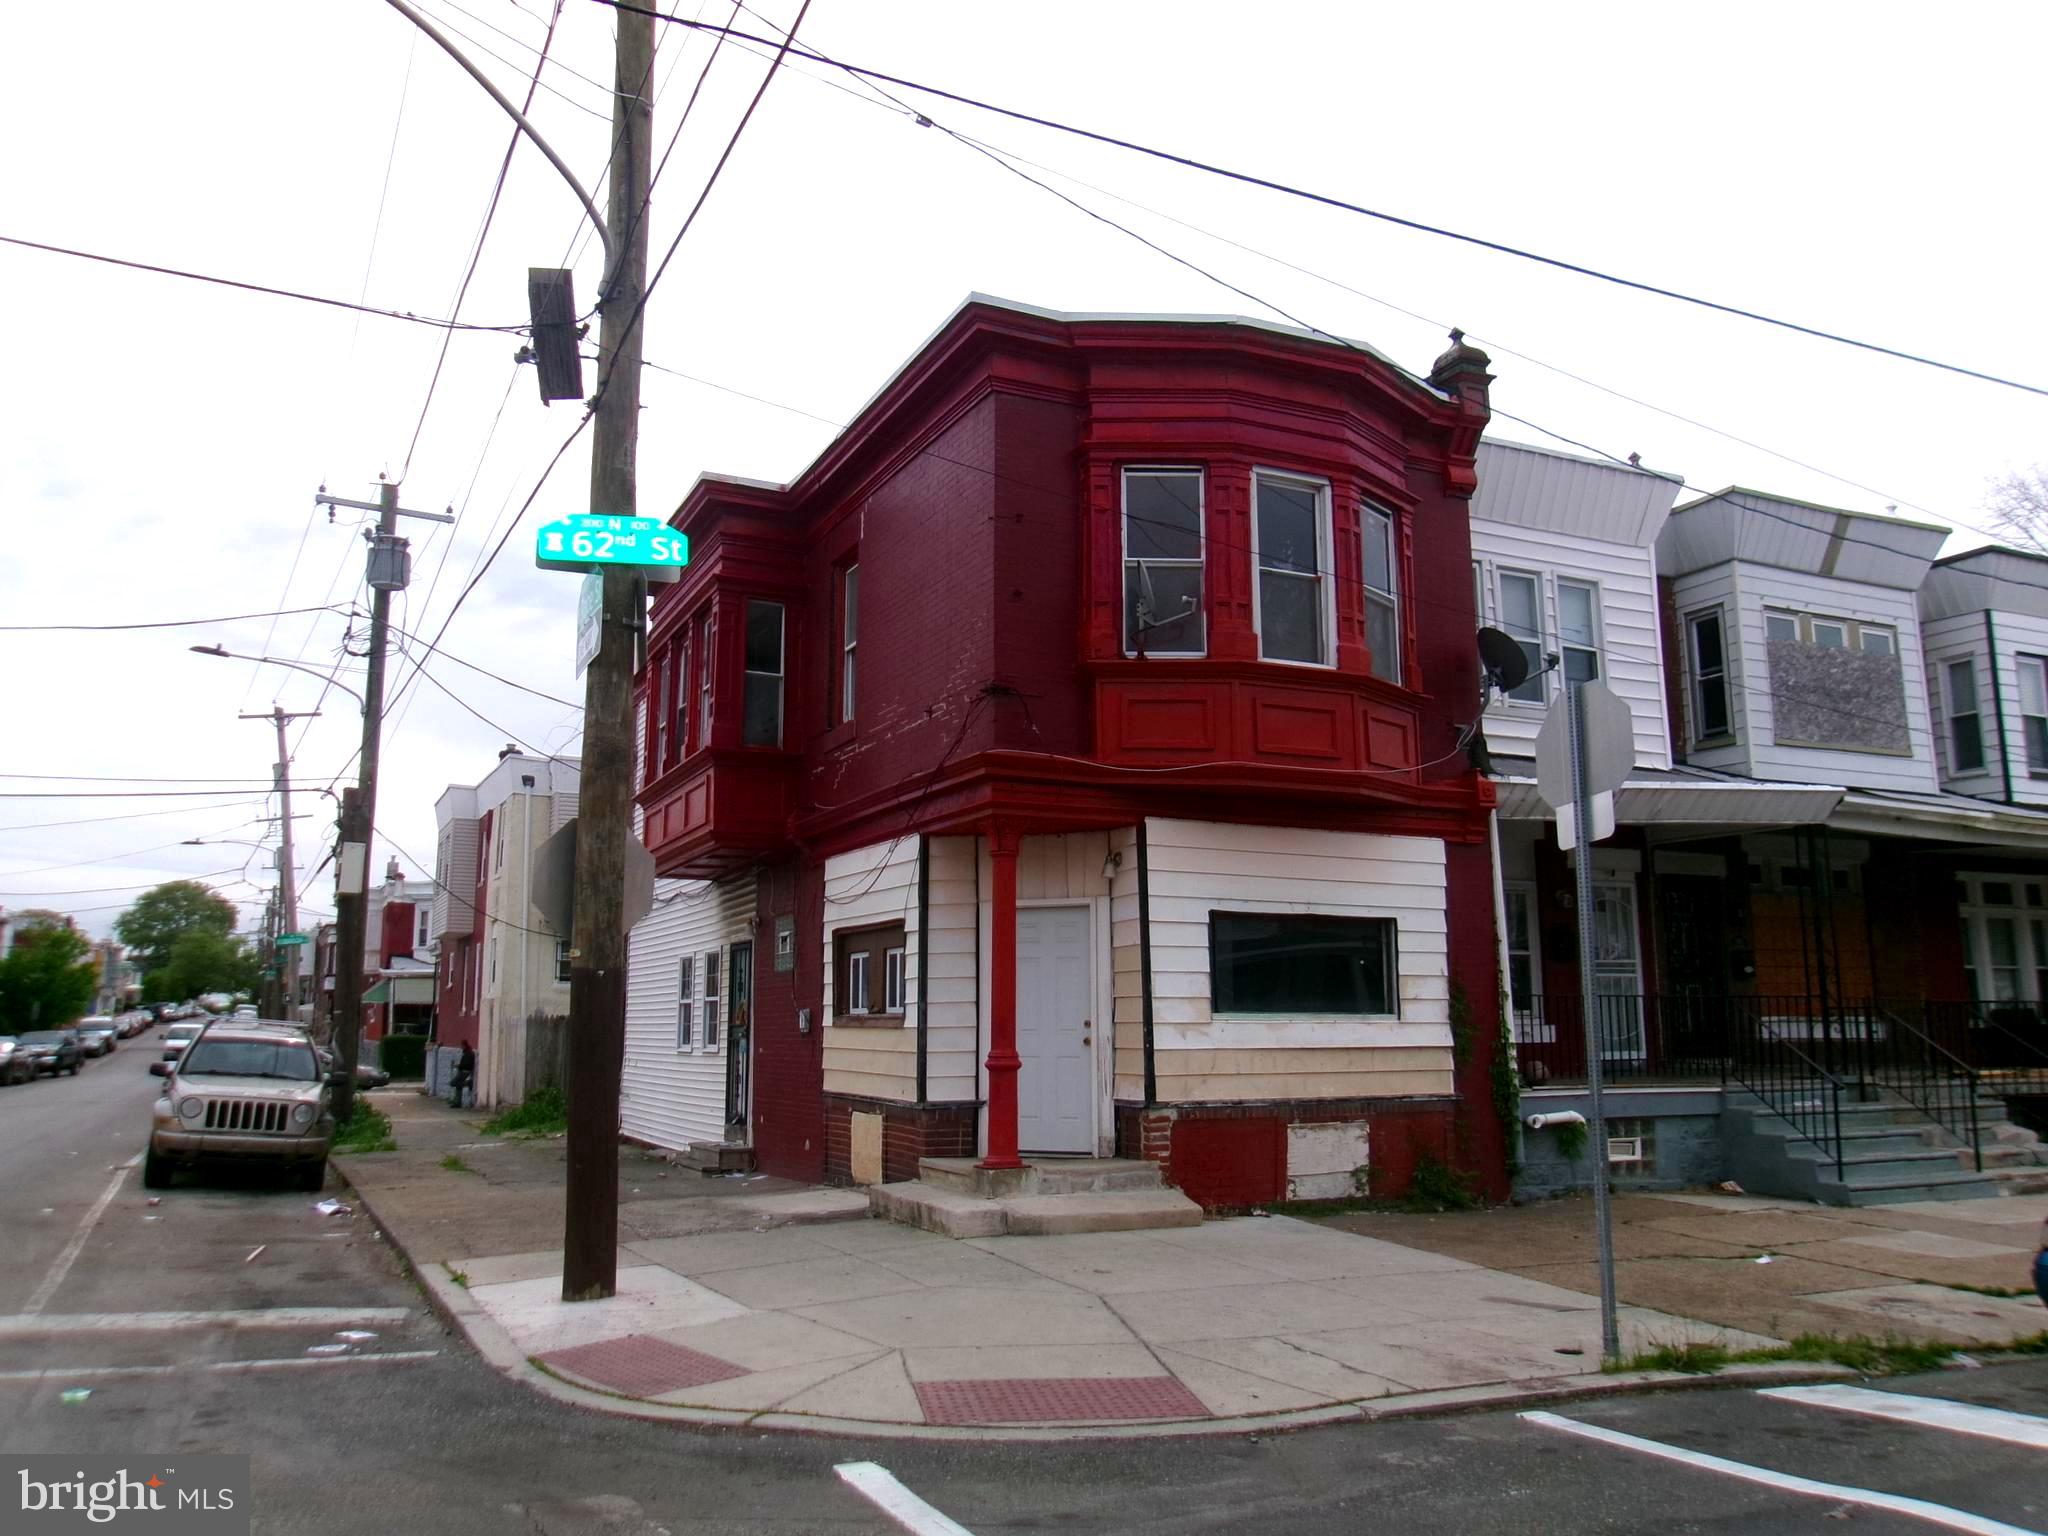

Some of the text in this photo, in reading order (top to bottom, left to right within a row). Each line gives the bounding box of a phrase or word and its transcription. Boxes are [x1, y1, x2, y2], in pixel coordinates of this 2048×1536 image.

[609, 518, 621, 530] N
[573, 531, 682, 560] 62nd St
